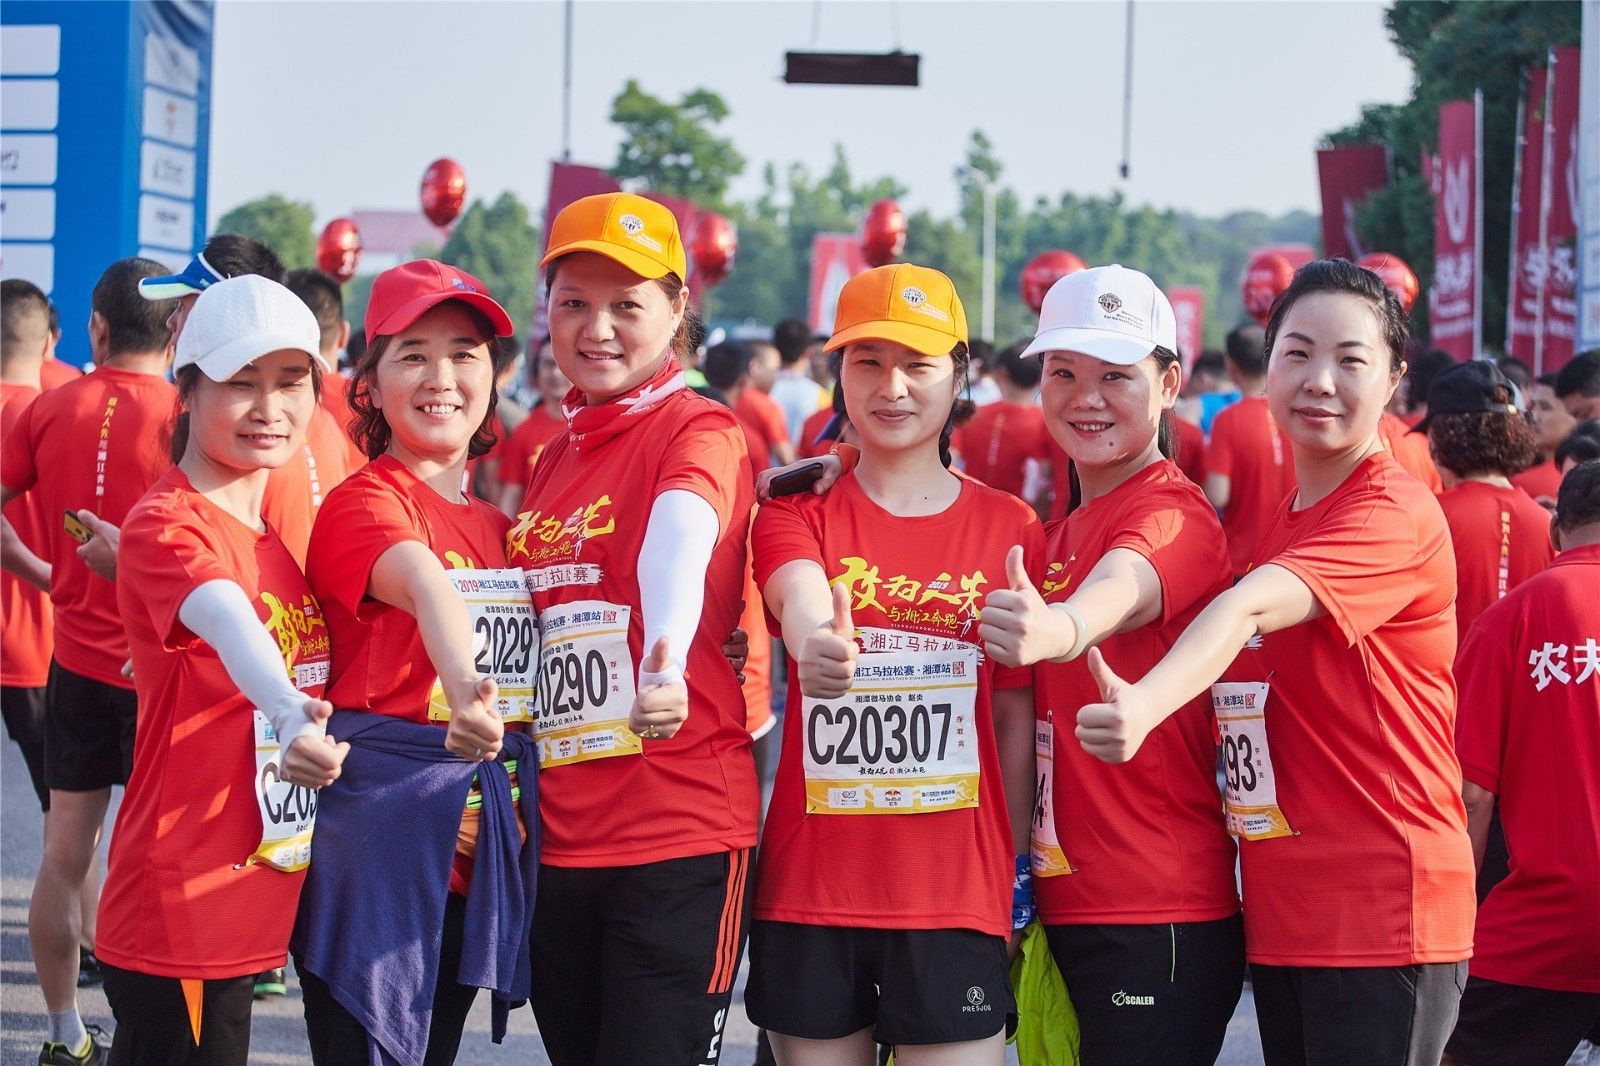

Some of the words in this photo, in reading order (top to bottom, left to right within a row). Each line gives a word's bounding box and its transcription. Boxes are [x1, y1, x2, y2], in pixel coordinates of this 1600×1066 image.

[887, 605, 958, 630] 与湘江奔跑
[1527, 637, 1600, 692] 农夫
[807, 703, 952, 765] C20307
[1125, 994, 1155, 1006] SCALER
